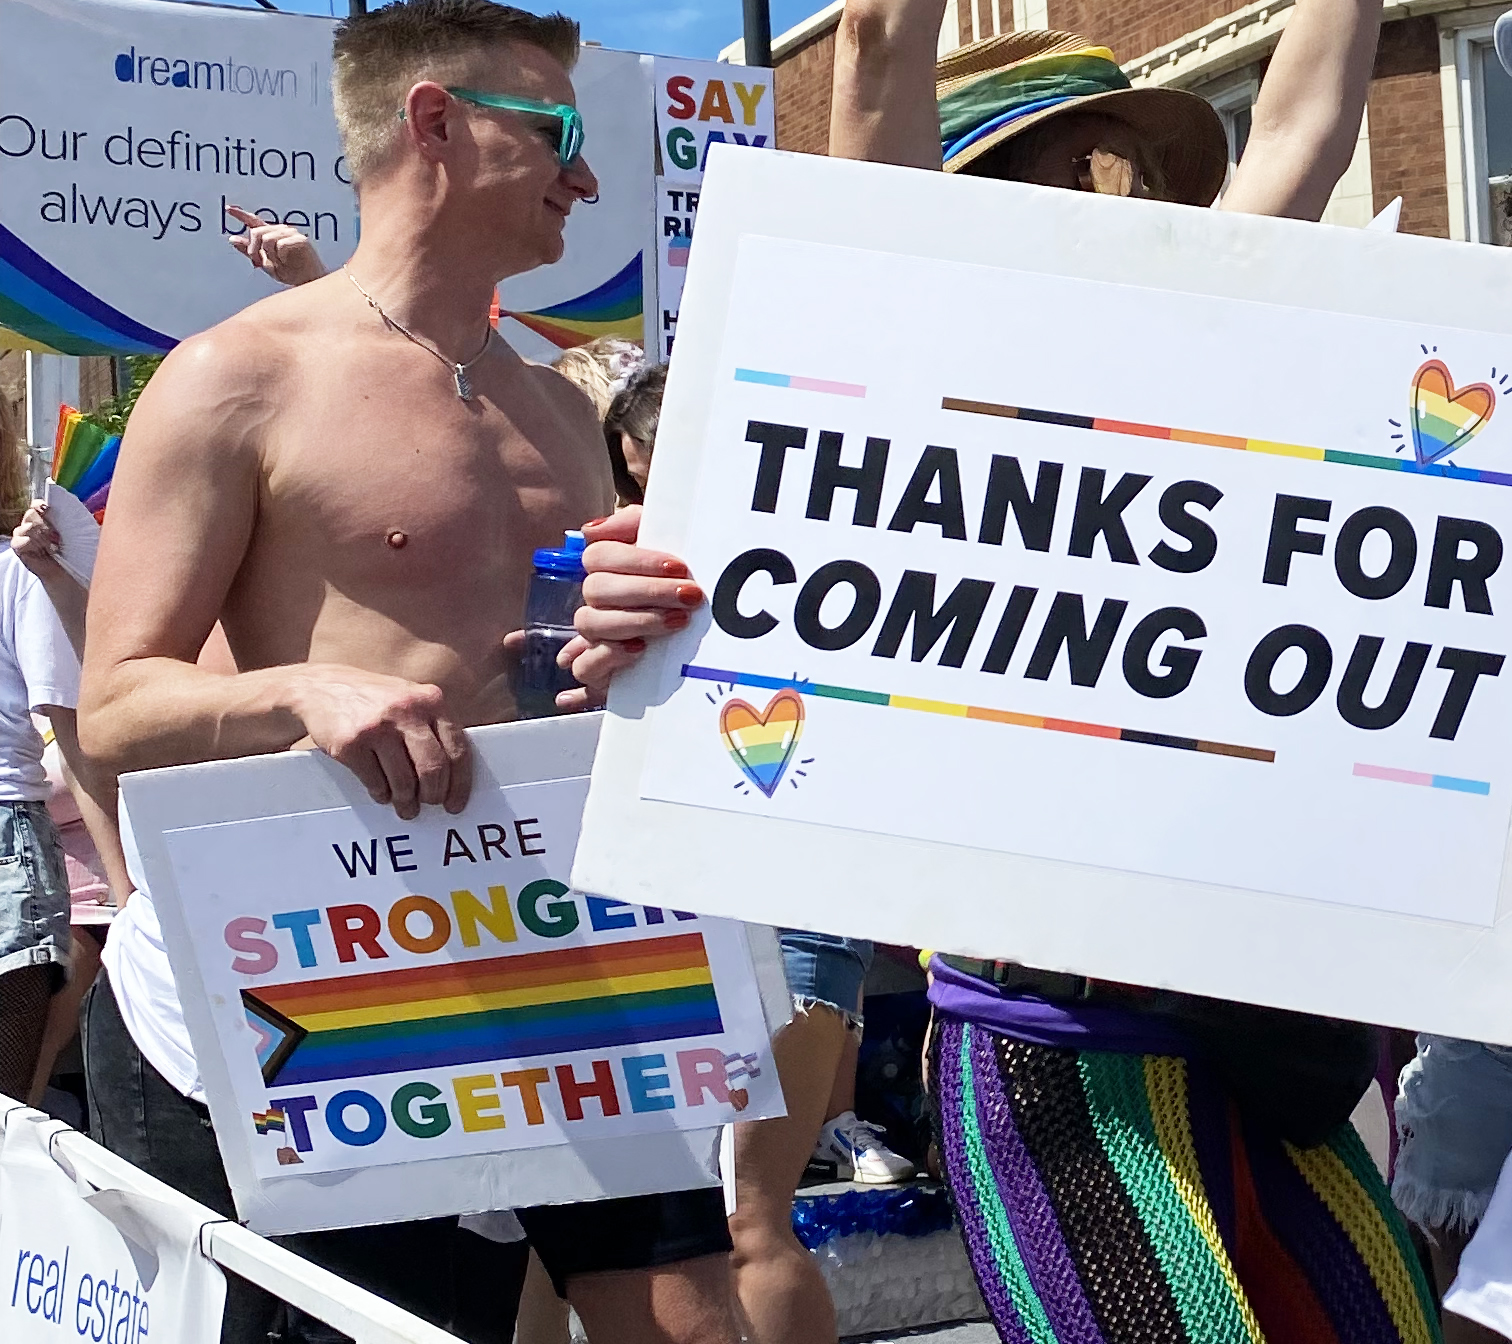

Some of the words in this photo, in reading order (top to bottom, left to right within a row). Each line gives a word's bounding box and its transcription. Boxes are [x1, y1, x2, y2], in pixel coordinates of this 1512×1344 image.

[115, 45, 298, 99] dreamtown
[666, 75, 767, 126] SAY
[0, 114, 87, 161] Our
[105, 126, 315, 181] definition
[41, 183, 202, 240] always
[743, 419, 1223, 574] THANKS
[1262, 492, 1505, 616] FOR
[711, 547, 1208, 700] COMING
[1242, 622, 1505, 740] OUT
[332, 837, 419, 879] WE
[441, 818, 547, 869] ARE
[266, 1046, 735, 1154] TOGETHER
[11, 1245, 69, 1324] real
